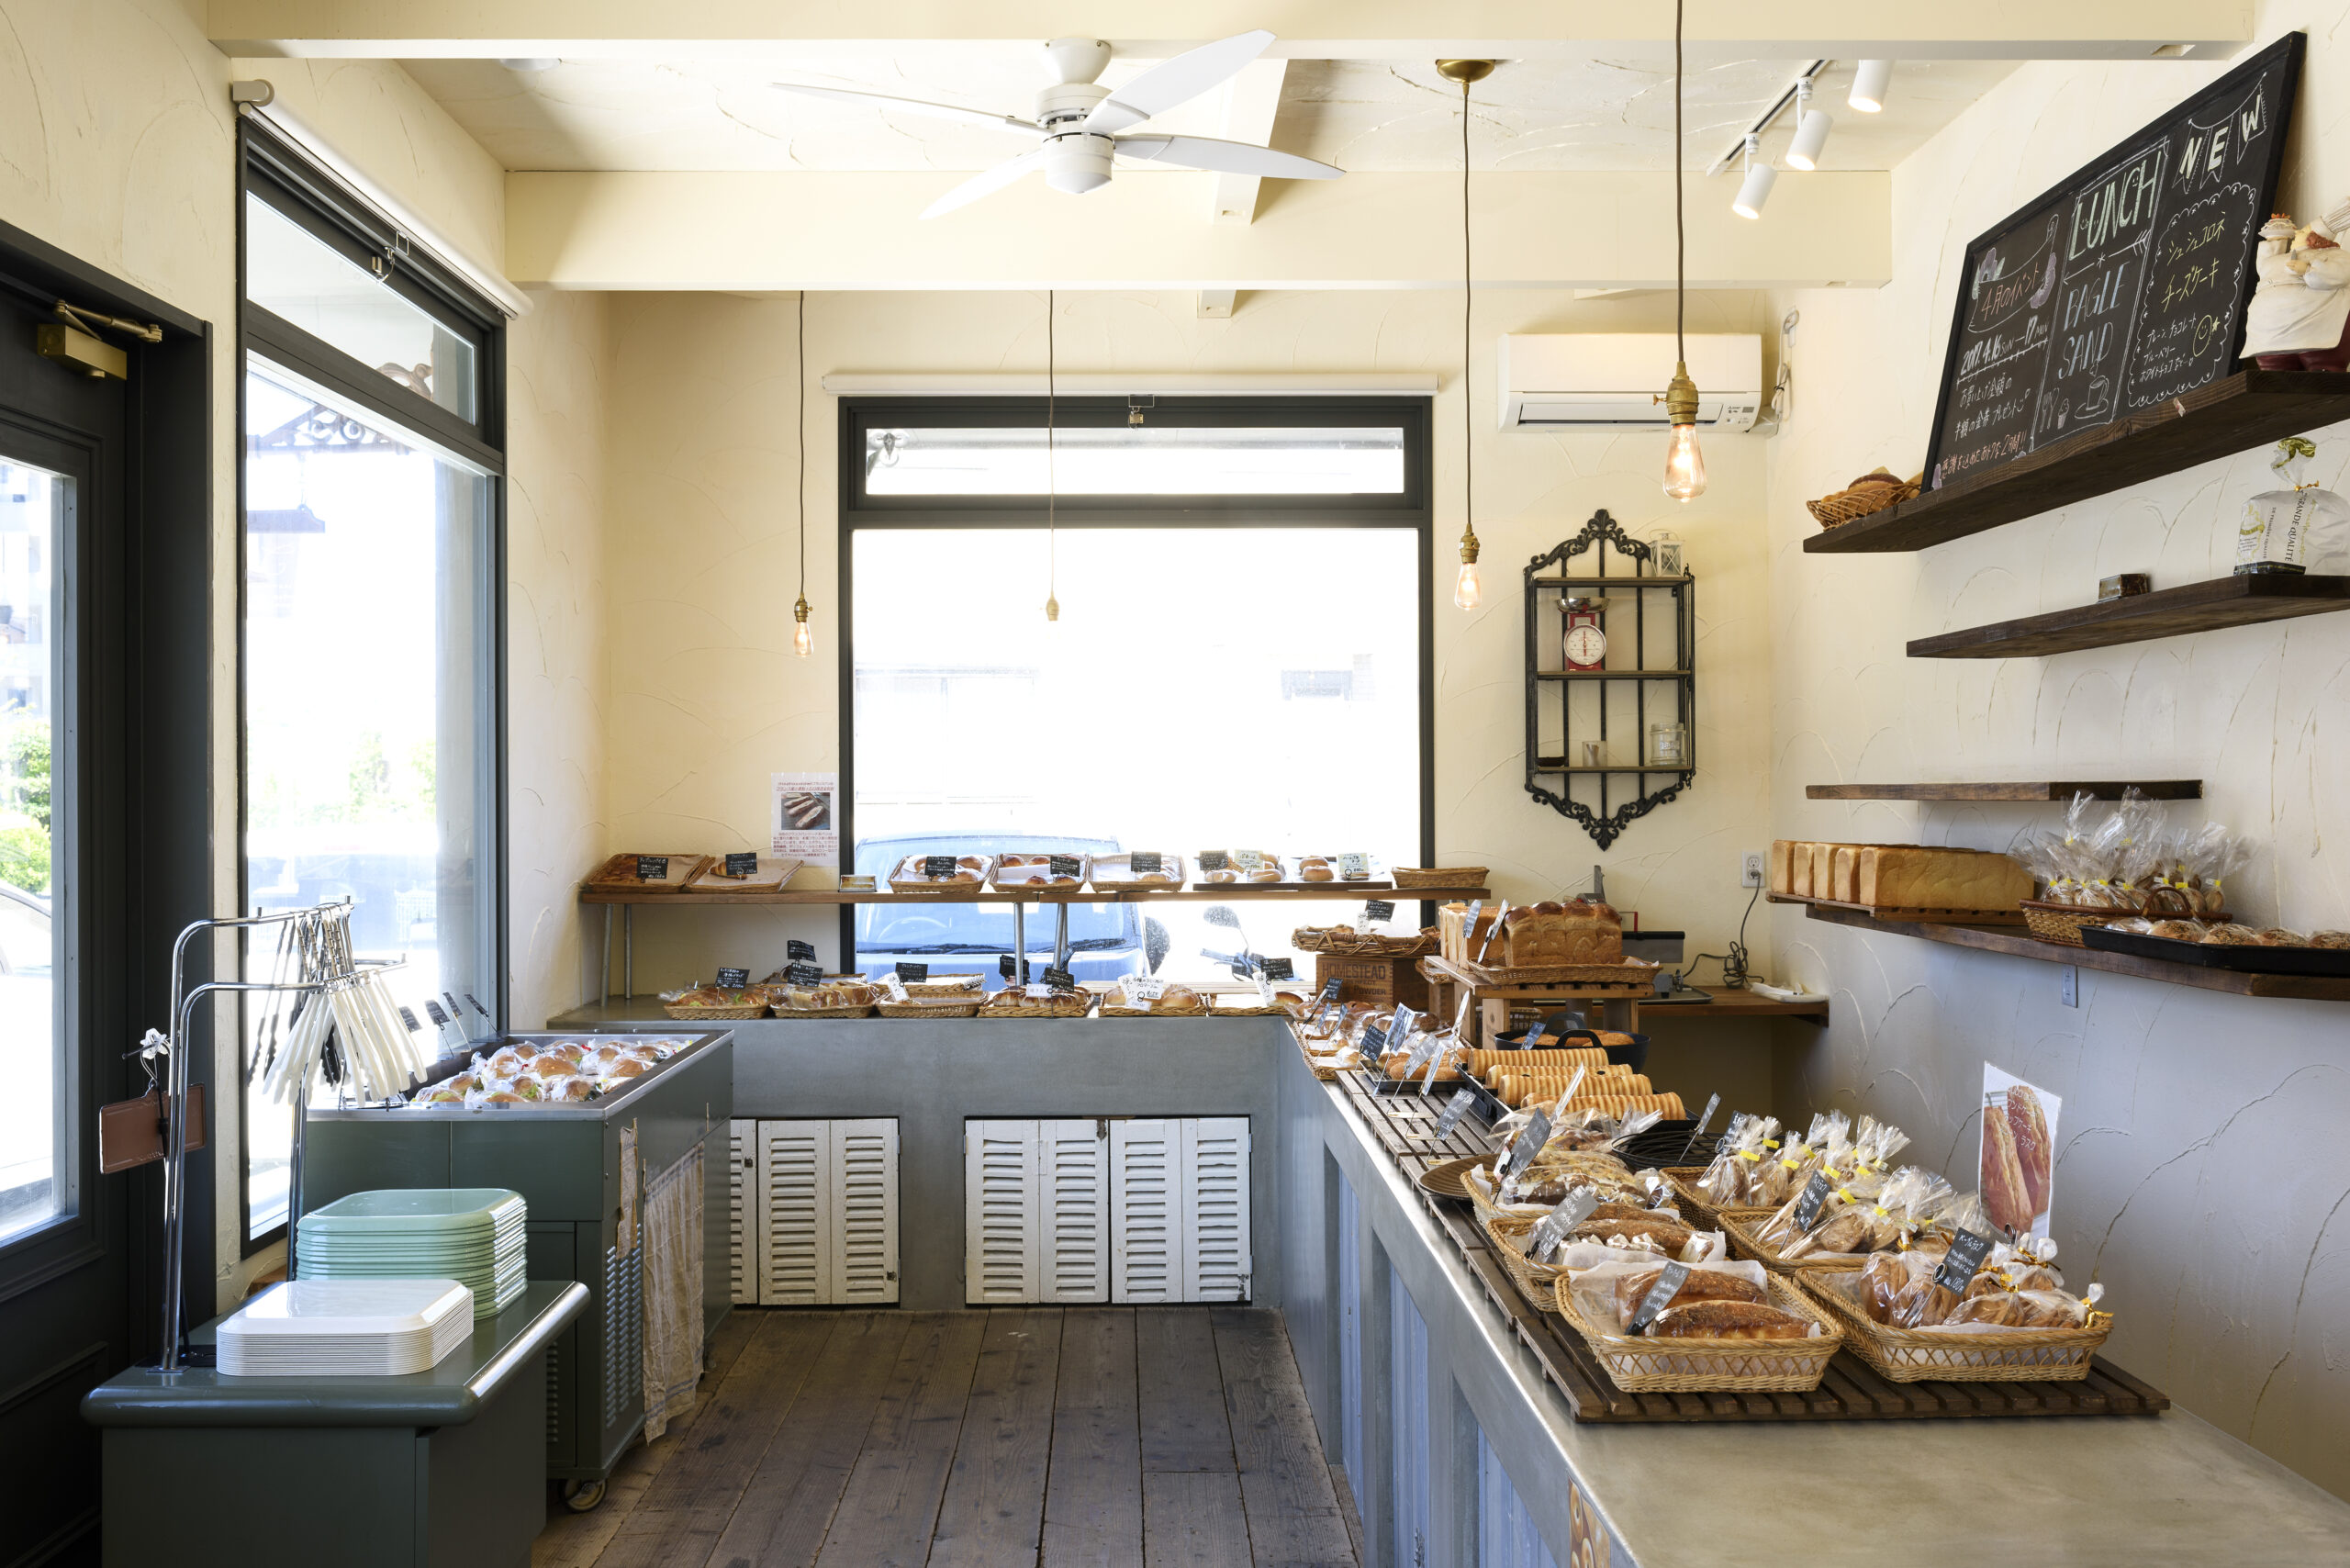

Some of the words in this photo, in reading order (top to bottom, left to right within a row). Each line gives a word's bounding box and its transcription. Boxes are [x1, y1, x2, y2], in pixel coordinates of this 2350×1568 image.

[2179, 95, 2261, 179] NEW
[2069, 151, 2162, 261] LUNCH
[2167, 211, 2226, 266] シュシュコロネ
[1981, 262, 2039, 321] 4月のイベント
[2064, 261, 2131, 331] BAGLE
[2161, 257, 2220, 313] チーズケーキ
[2059, 321, 2113, 379] SAND
[1322, 961, 1386, 980] HOMESTEAD
[1353, 985, 1386, 995] POWDER
